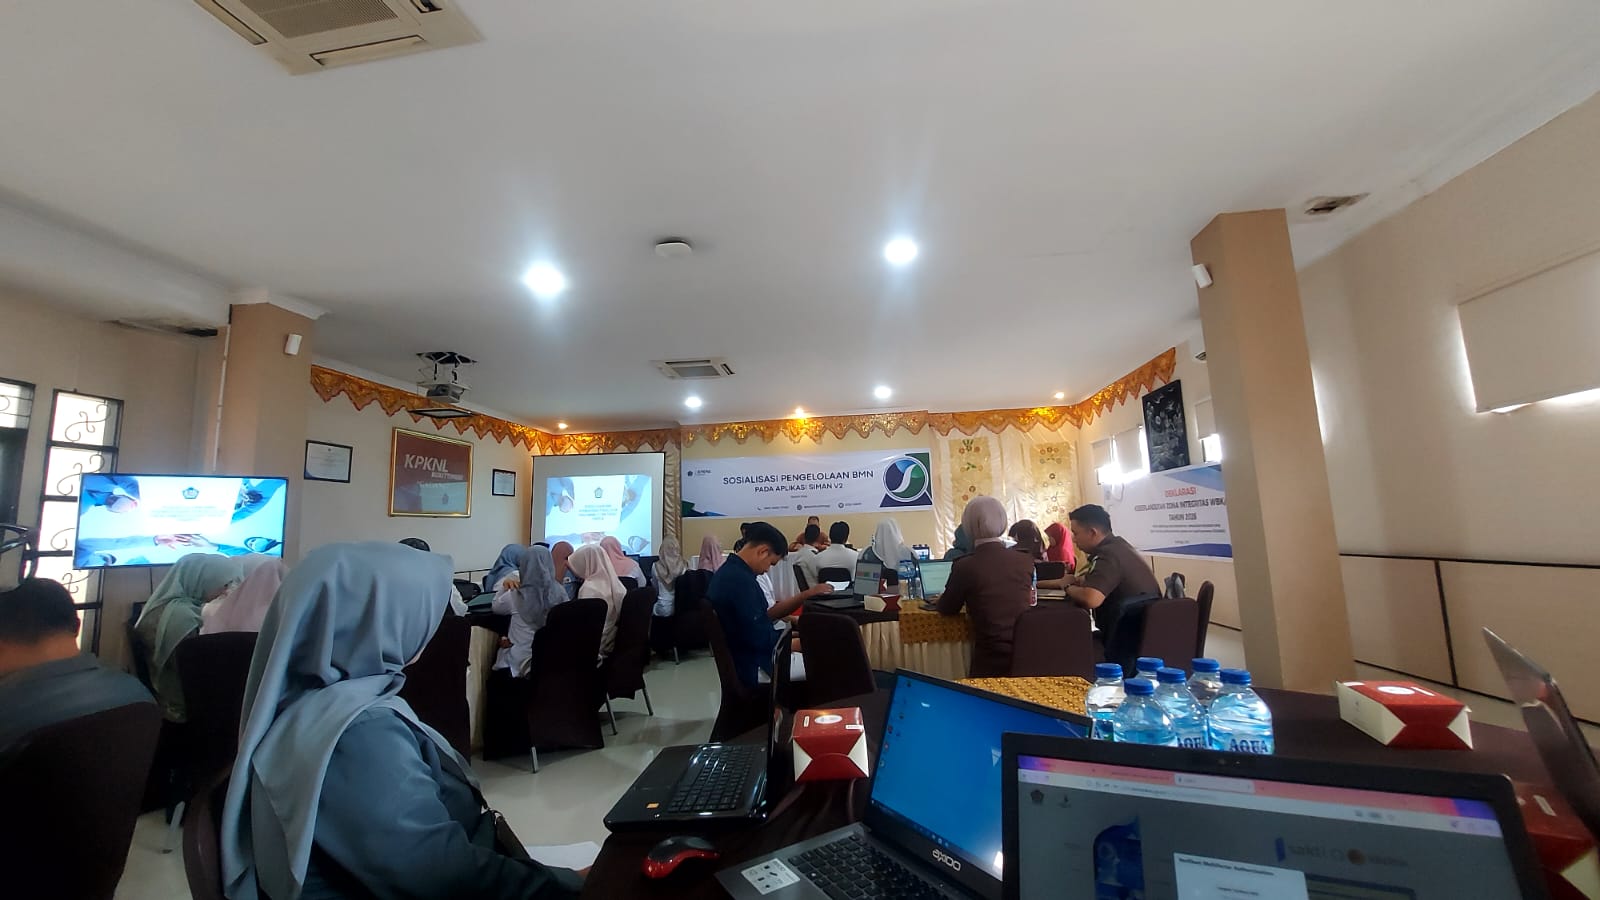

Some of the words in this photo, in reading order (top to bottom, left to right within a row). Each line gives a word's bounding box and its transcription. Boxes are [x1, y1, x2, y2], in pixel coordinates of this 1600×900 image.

[404, 454, 448, 472] KPKNL
[723, 475, 778, 485] SOSIALISASI
[781, 471, 850, 482] PENGELOLAAN
[852, 470, 874, 479] BMN
